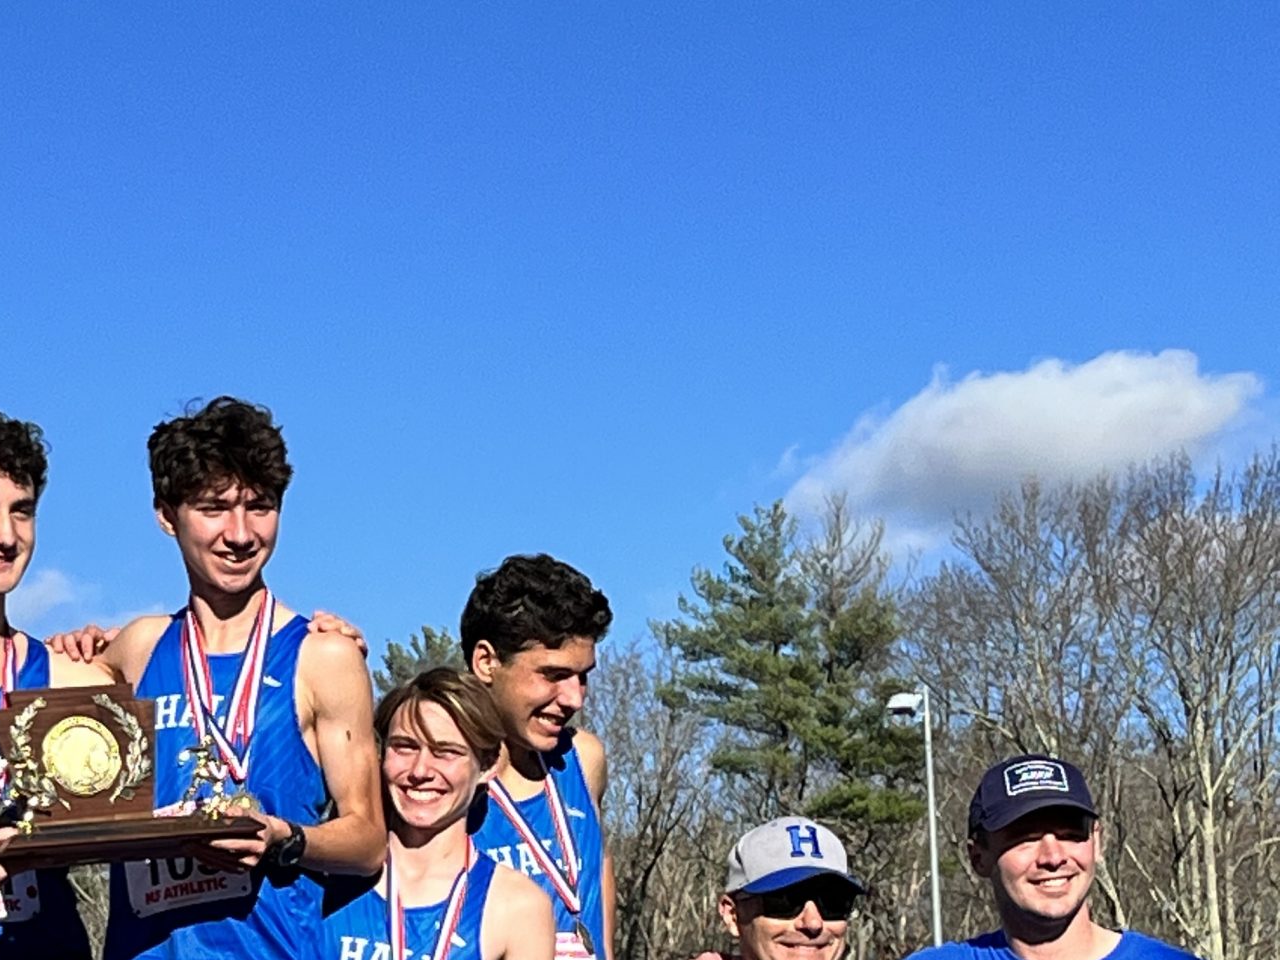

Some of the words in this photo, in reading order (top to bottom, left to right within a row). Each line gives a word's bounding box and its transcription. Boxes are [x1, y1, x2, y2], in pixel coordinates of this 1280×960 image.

[786, 824, 824, 859] H
[147, 857, 222, 886] 10
[163, 876, 228, 900] ATHLETIC
